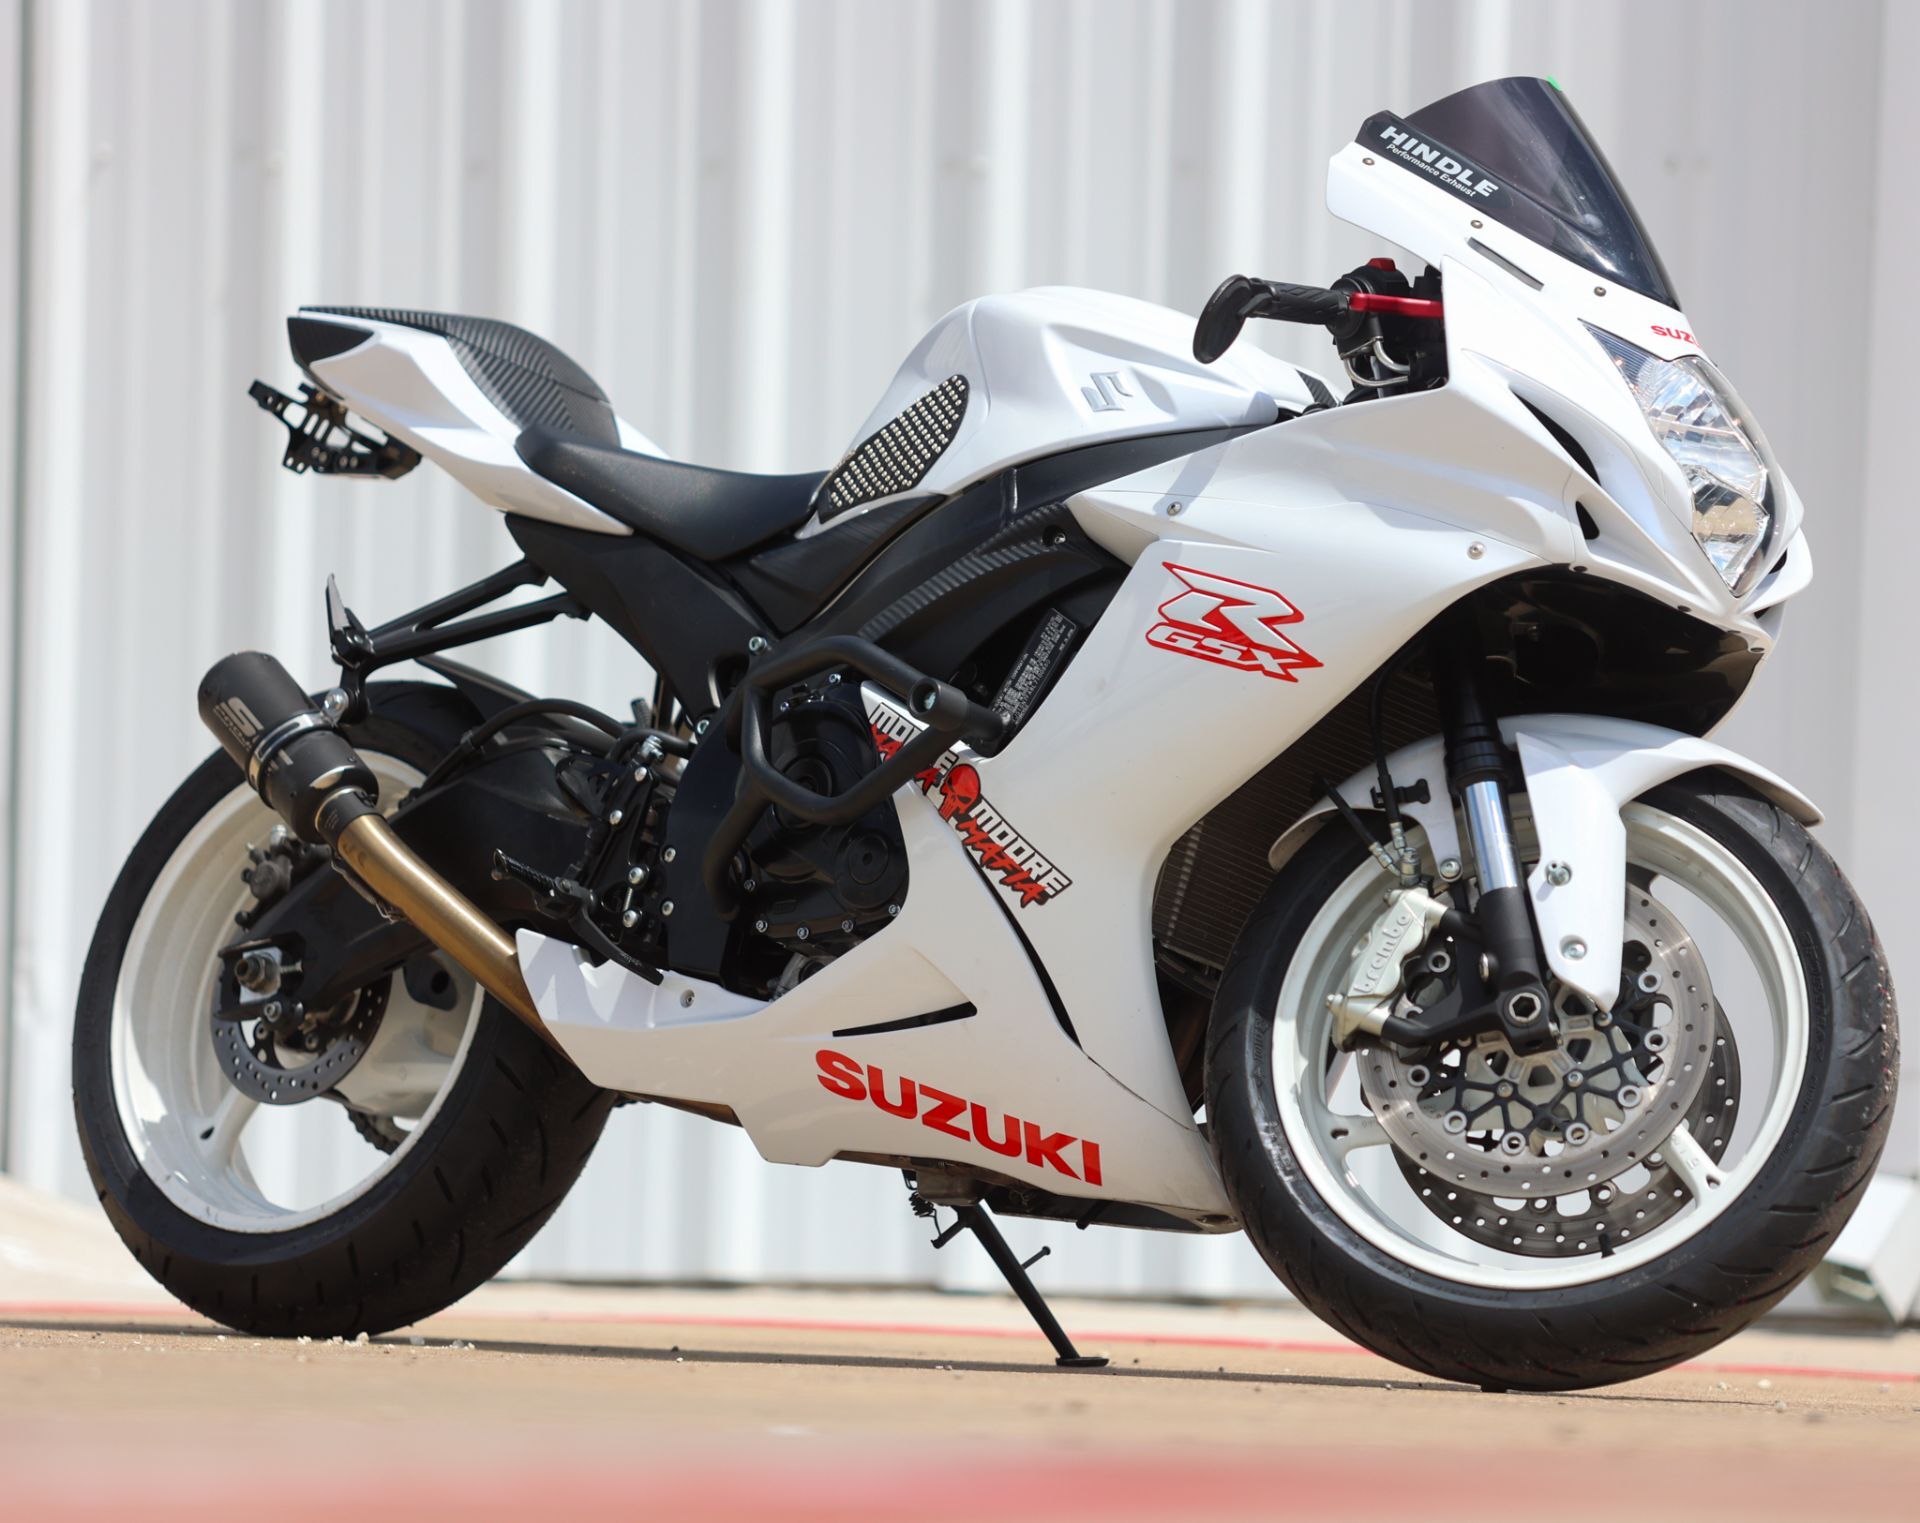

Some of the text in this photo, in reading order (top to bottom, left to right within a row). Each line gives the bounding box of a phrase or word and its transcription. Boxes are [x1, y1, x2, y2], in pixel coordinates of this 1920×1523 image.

[1380, 126, 1499, 197] HINDLE
[1386, 143, 1476, 197] Performance Exhaust
[1651, 325, 1702, 347] SUZ
[1146, 622, 1306, 680] GSX
[869, 703, 959, 776] MOE
[955, 817, 1049, 908] MAFIA
[968, 797, 1073, 898] MOORE
[1353, 912, 1411, 993] brembo
[815, 1049, 1103, 1187] SUZUKI
